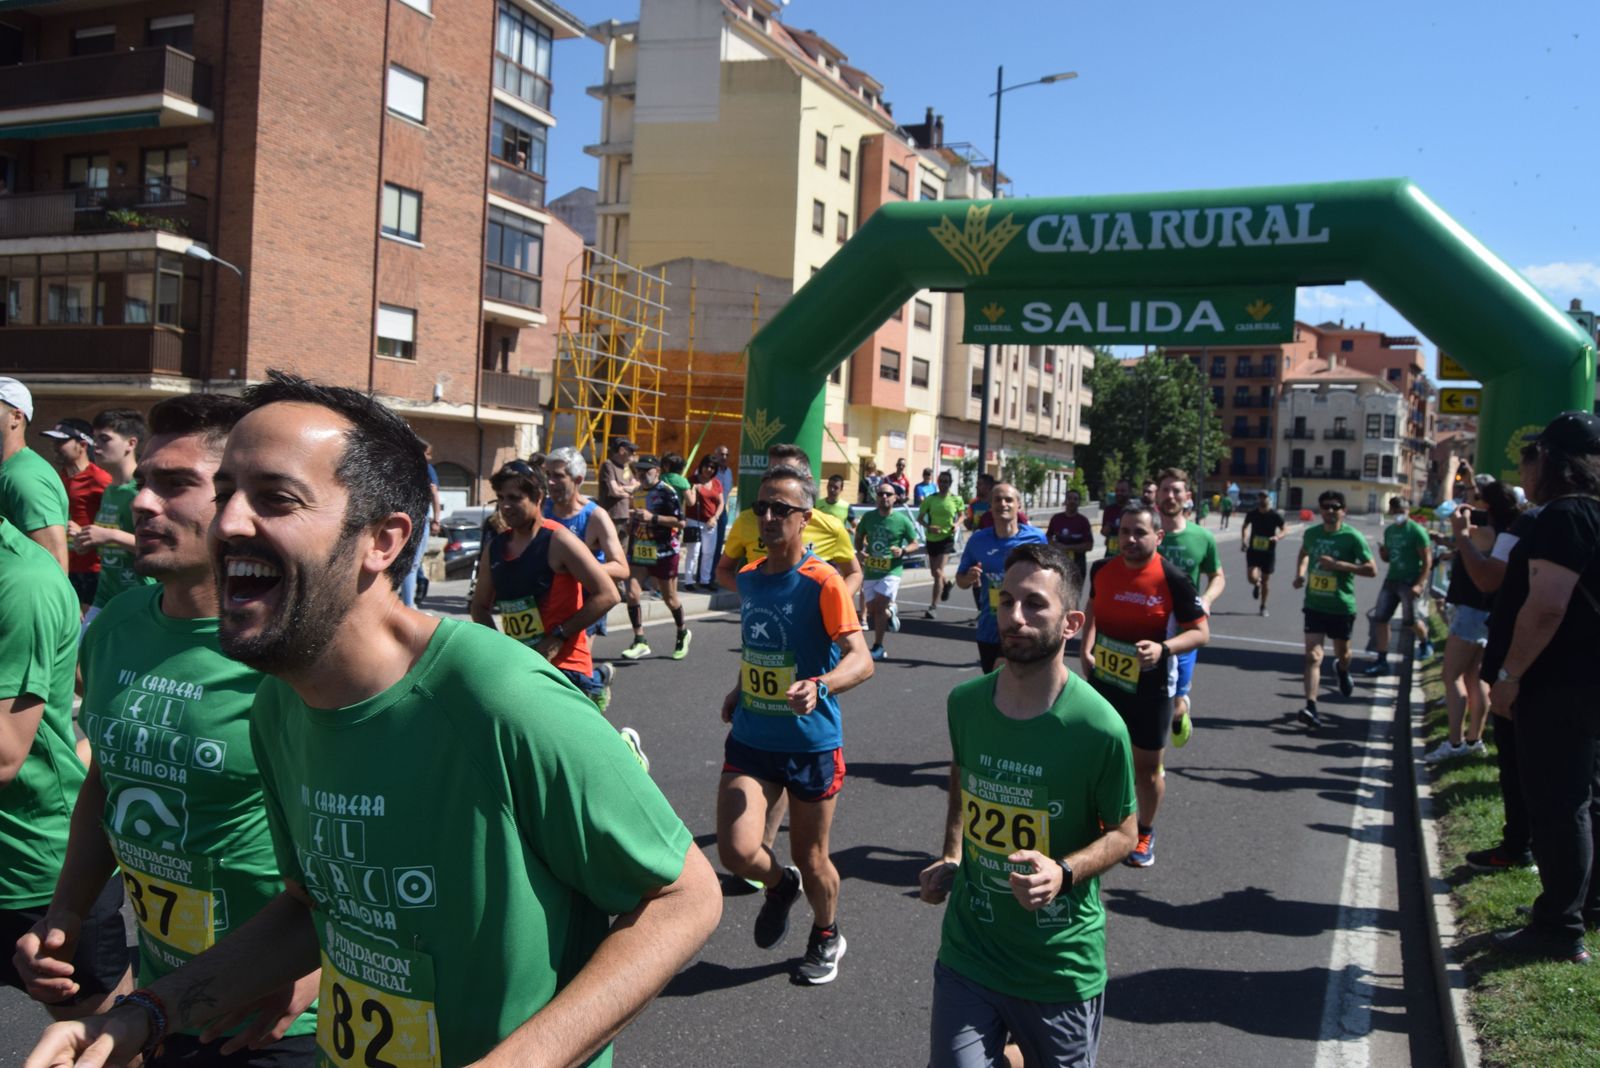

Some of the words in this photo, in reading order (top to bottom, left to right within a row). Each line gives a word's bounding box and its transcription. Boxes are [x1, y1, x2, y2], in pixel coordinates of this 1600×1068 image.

[1027, 210, 1143, 254] CAJA
[1148, 202, 1330, 248] RURAL
[1021, 299, 1225, 334] SALIDA
[637, 546, 653, 557] 181
[870, 558, 888, 569] 212
[1314, 575, 1329, 589] 79
[1099, 650, 1133, 677] 192
[118, 669, 136, 686] VII
[142, 674, 205, 700] CARRERA
[750, 668, 779, 696] 96
[100, 749, 116, 767] DE
[124, 756, 188, 783] ZAMORA
[980, 754, 991, 767] VII
[997, 759, 1043, 777] CARRERA
[315, 789, 385, 816] CARRERA
[978, 779, 1034, 798] FUNDACION
[978, 789, 999, 801] CAJA
[1000, 794, 1034, 807] RURAL
[968, 801, 1036, 850] 226
[119, 839, 193, 873] FUNDACION
[120, 851, 146, 870] CAJA
[150, 863, 193, 884] RURAL
[978, 855, 1000, 870] CAJA
[1003, 862, 1035, 874] RURA
[335, 932, 412, 977] FUNDACION
[335, 951, 359, 977] CAJA
[362, 964, 412, 993] RURAL
[332, 982, 398, 1068] 82
